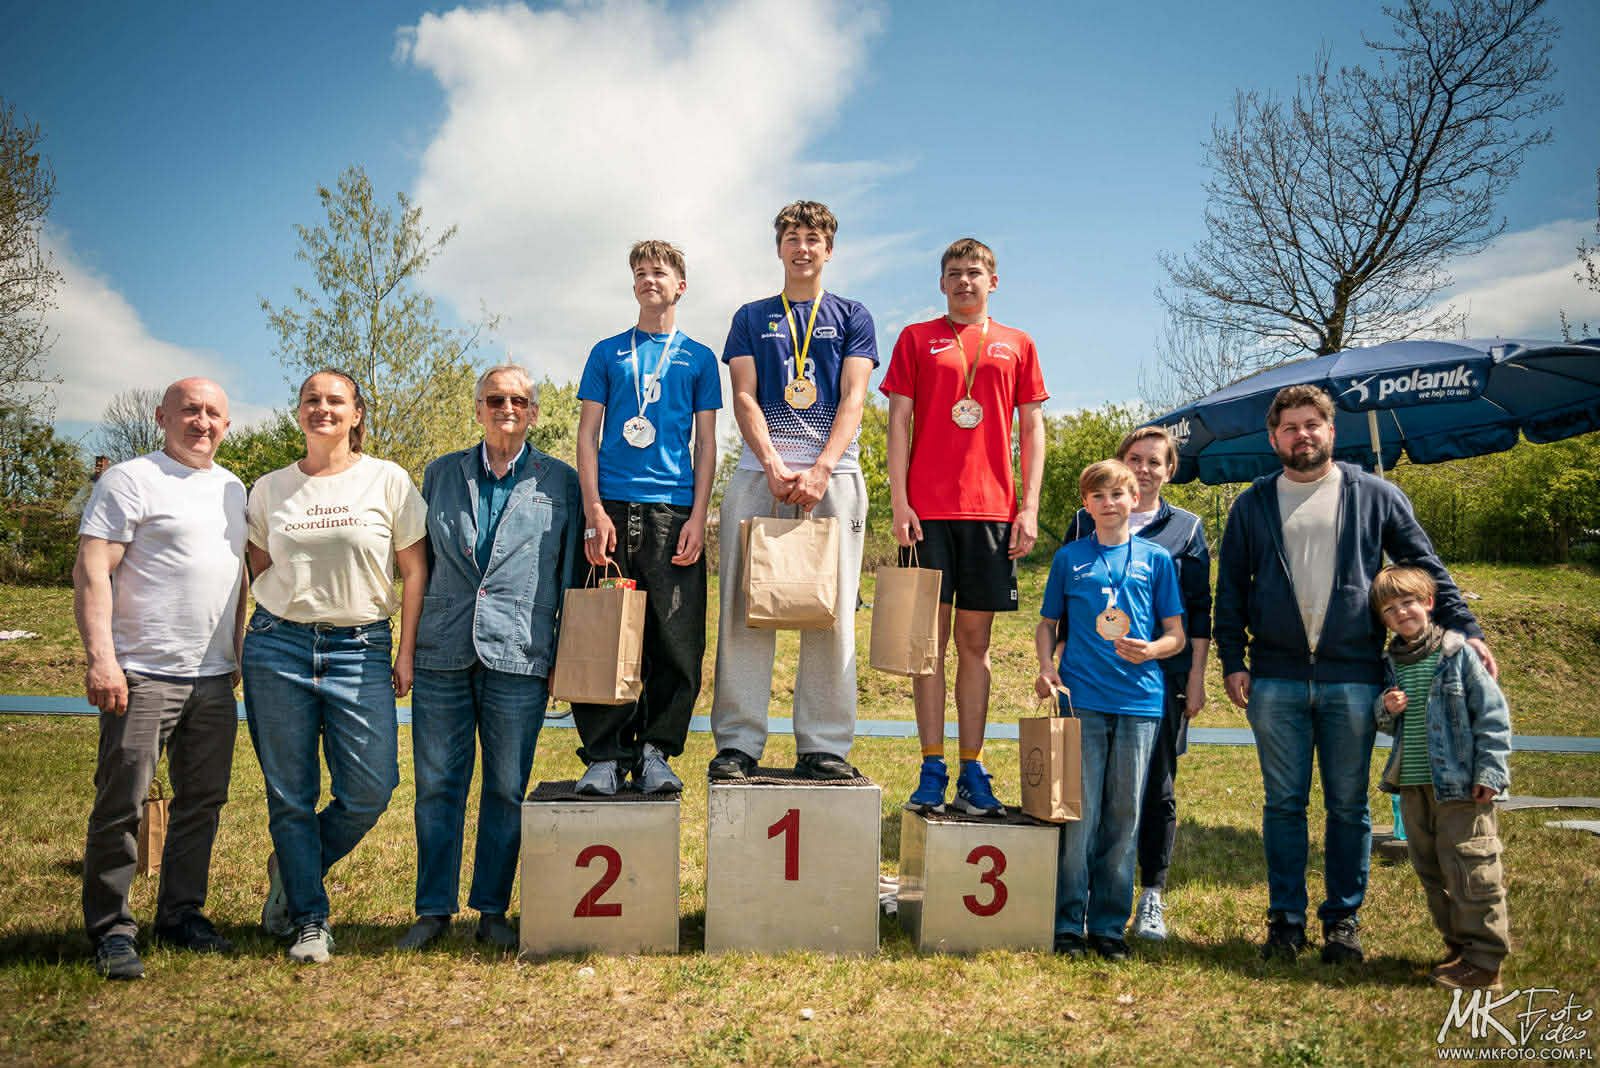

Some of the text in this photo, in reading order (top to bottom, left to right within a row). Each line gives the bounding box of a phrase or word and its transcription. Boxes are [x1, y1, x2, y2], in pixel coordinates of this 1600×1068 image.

[1378, 365, 1473, 401] polanik
[1418, 391, 1430, 399] we
[1431, 390, 1446, 398] help
[306, 504, 349, 516] chaos
[767, 808, 800, 881] 1
[573, 844, 622, 917] 2
[962, 844, 1008, 917] 3
